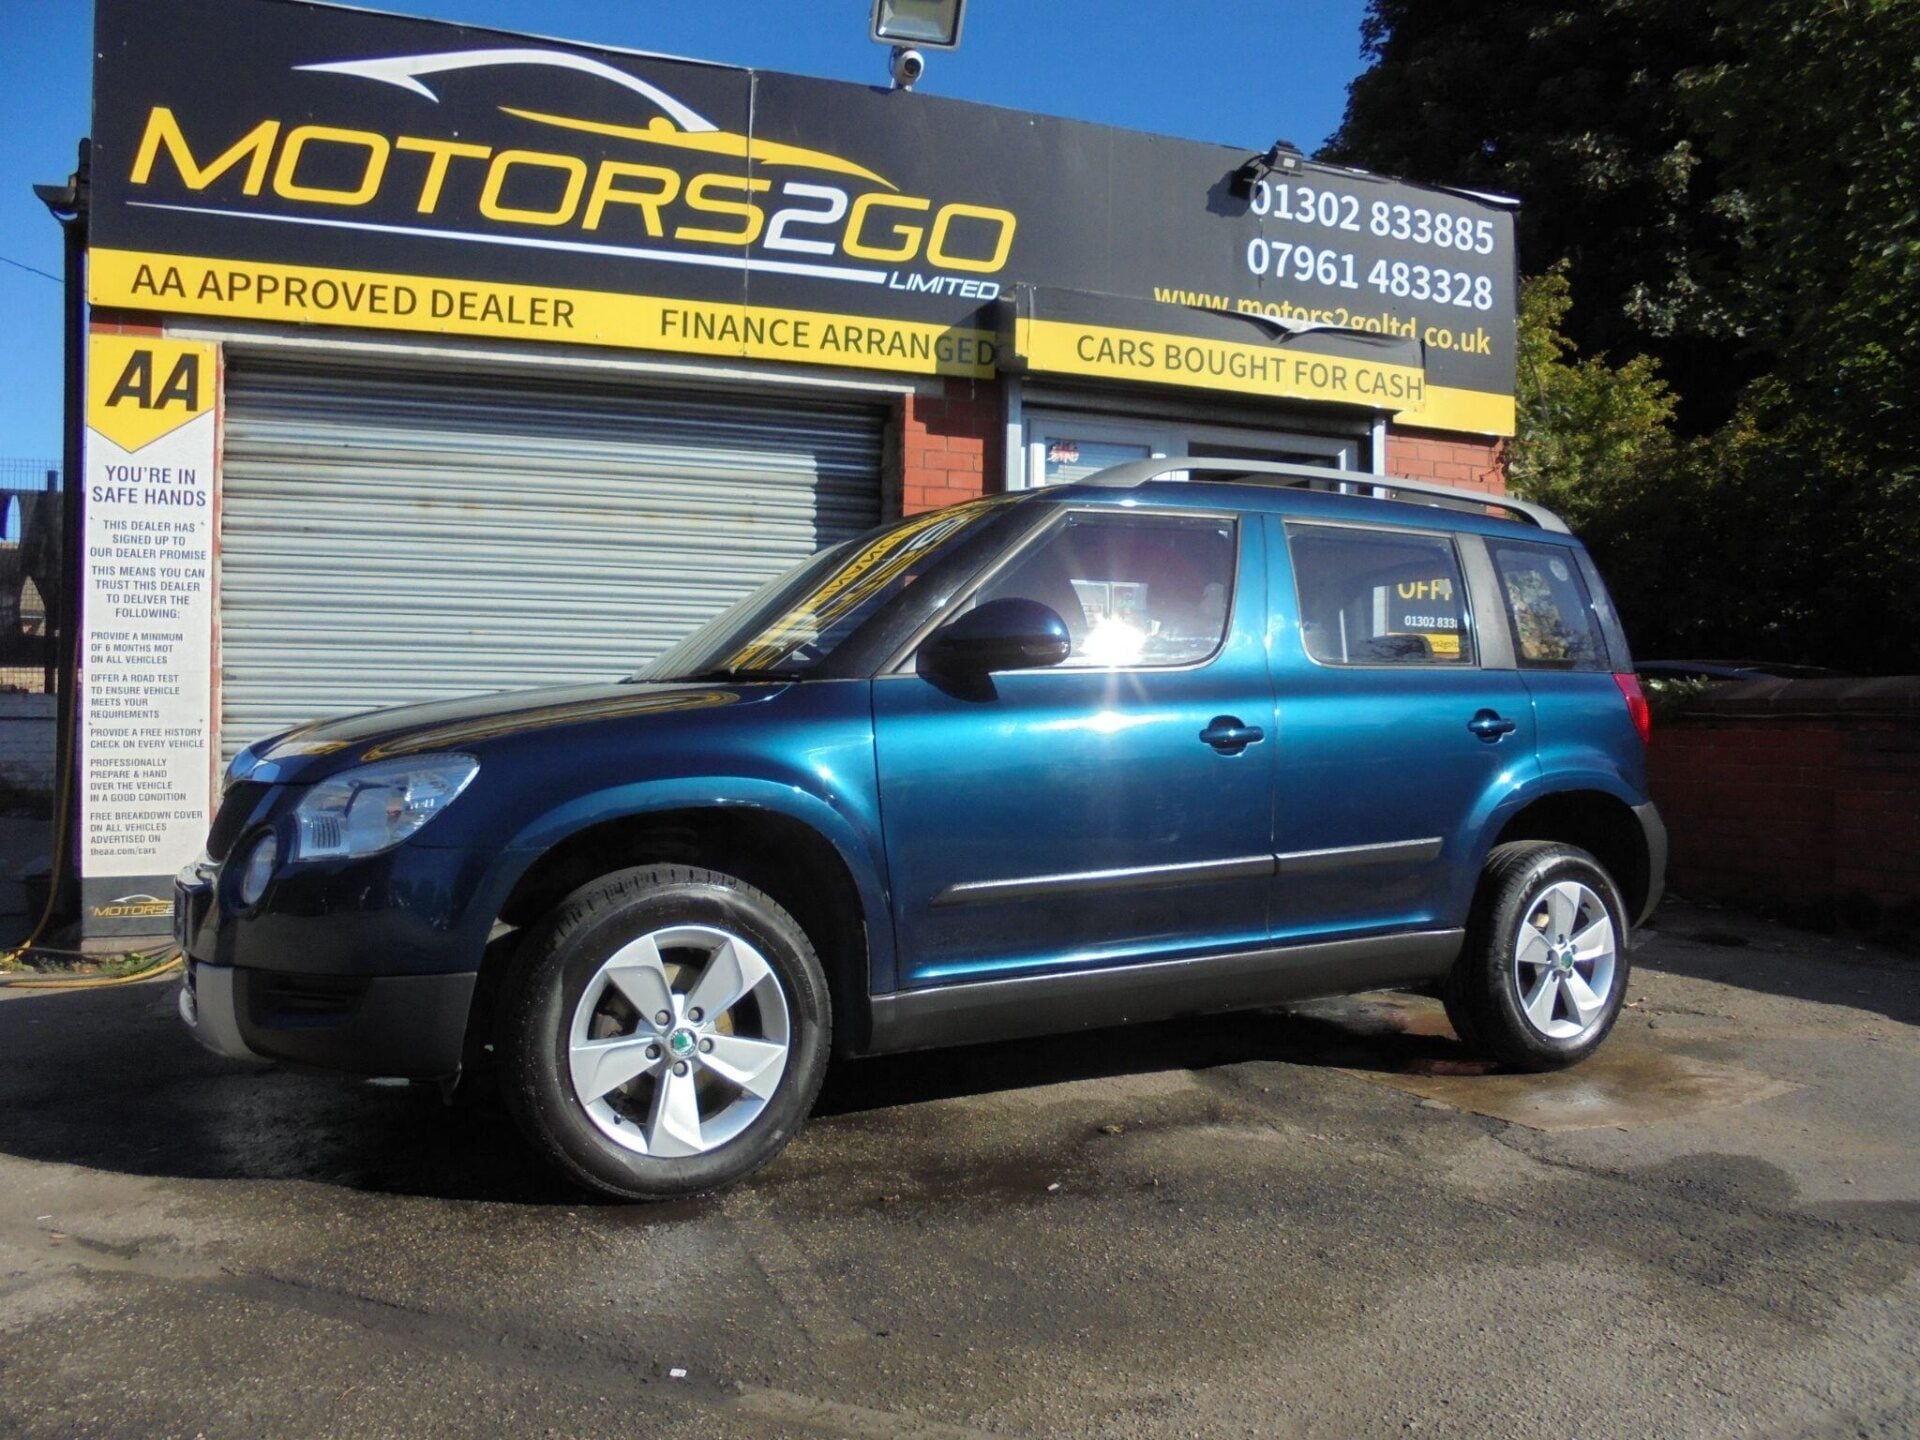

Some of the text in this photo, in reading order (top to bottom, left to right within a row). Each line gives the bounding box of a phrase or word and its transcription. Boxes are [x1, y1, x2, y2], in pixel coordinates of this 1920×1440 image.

[130, 106, 1017, 273] MOTORS2GO
[1250, 180, 1494, 255] 01302 833885
[1246, 237, 1494, 311] 07961 483328
[888, 271, 1000, 300] LIMITED
[130, 264, 575, 328] AA APPROVED DEALER
[660, 309, 996, 365] FINANCE ARRANGED
[1077, 334, 1423, 401] CARS BOUGHT FOR CASH
[104, 349, 199, 413] AA
[179, 469, 195, 485] IN
[93, 486, 206, 506] SAFE HANDS
[104, 520, 195, 532] THIS DEALER HAS
[113, 535, 186, 546] SIGNED UP TO
[90, 547, 207, 560] OUR DEALER PROMISE
[92, 566, 205, 578] THIS MEANS YOU CAN
[96, 580, 200, 592] TRUST THIS DEALER
[107, 594, 190, 605] TO DELIVER THE
[116, 608, 180, 618] FOLLOWING:
[1404, 615, 1435, 628] 01302
[91, 632, 183, 642] PROVIDE A MINIMUM
[91, 644, 173, 653] OF 6 MONTHS MOT
[91, 655, 168, 664] ON ALL VEHICLES
[91, 674, 179, 683] OFFER A ROAD TEST
[91, 686, 180, 695] TO ENSURE VEHICLE
[91, 698, 148, 706] MEETS YOUR
[90, 710, 159, 719] REQUIREMENTS
[90, 728, 202, 737] PROVIDE A FREE HISTORY
[90, 740, 204, 748] CHECK ON EVERY VEHICLE
[90, 759, 167, 767] PROFESSIONALLY
[90, 770, 130, 779] PREPARE
[143, 770, 167, 778] HAND
[90, 781, 173, 791] OVER THE VEHICLE
[90, 793, 186, 802] IN A GOOD CONDITION
[90, 811, 202, 821] FREE BREAKDOWN COVER
[90, 823, 167, 832] ON ALL VEHICLES
[91, 834, 161, 844] ADVERTISED ON
[90, 847, 156, 856] theaa.com/cars
